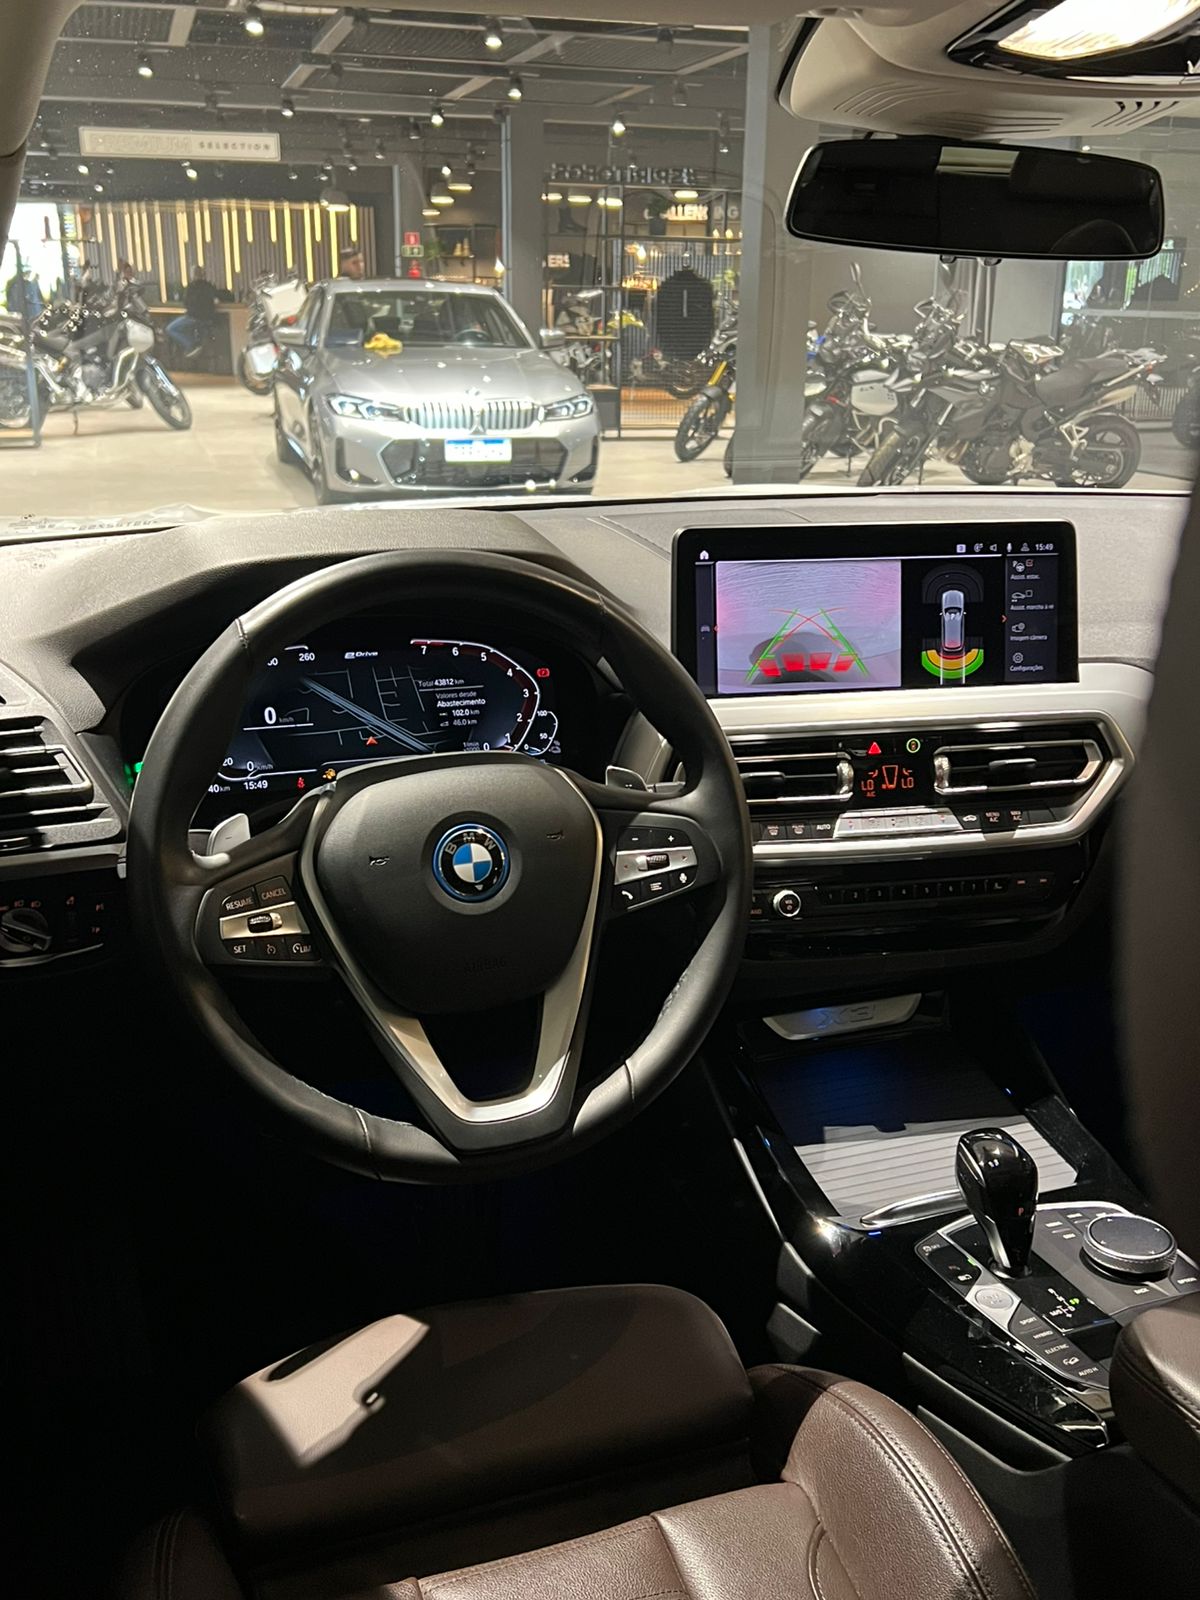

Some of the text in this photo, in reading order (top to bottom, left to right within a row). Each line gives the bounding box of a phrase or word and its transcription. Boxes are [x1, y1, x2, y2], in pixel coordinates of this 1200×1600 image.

[199, 140, 271, 151] SELECTION
[1035, 543, 1054, 551] 15:49
[420, 645, 428, 655] 7
[451, 646, 460, 657] 6
[298, 652, 316, 662] 260
[480, 651, 488, 662] 5
[506, 667, 514, 677] 4
[433, 678, 455, 687] 43812
[435, 690, 477, 700] Valores desde
[522, 688, 530, 698] 3
[436, 698, 486, 708] Abastecimento
[264, 706, 277, 725] 0
[451, 708, 470, 717] 102.0
[516, 712, 523, 722] 2
[246, 760, 254, 772] 0
[243, 780, 268, 790] 15:49
[861, 779, 874, 791] LO
[901, 777, 914, 788] LO
[445, 831, 496, 855] BMW
[261, 887, 287, 900] CANCEL
[225, 896, 253, 911] RESUME
[233, 944, 247, 954] SET
[1044, 1343, 1069, 1355] ELECTRIC
